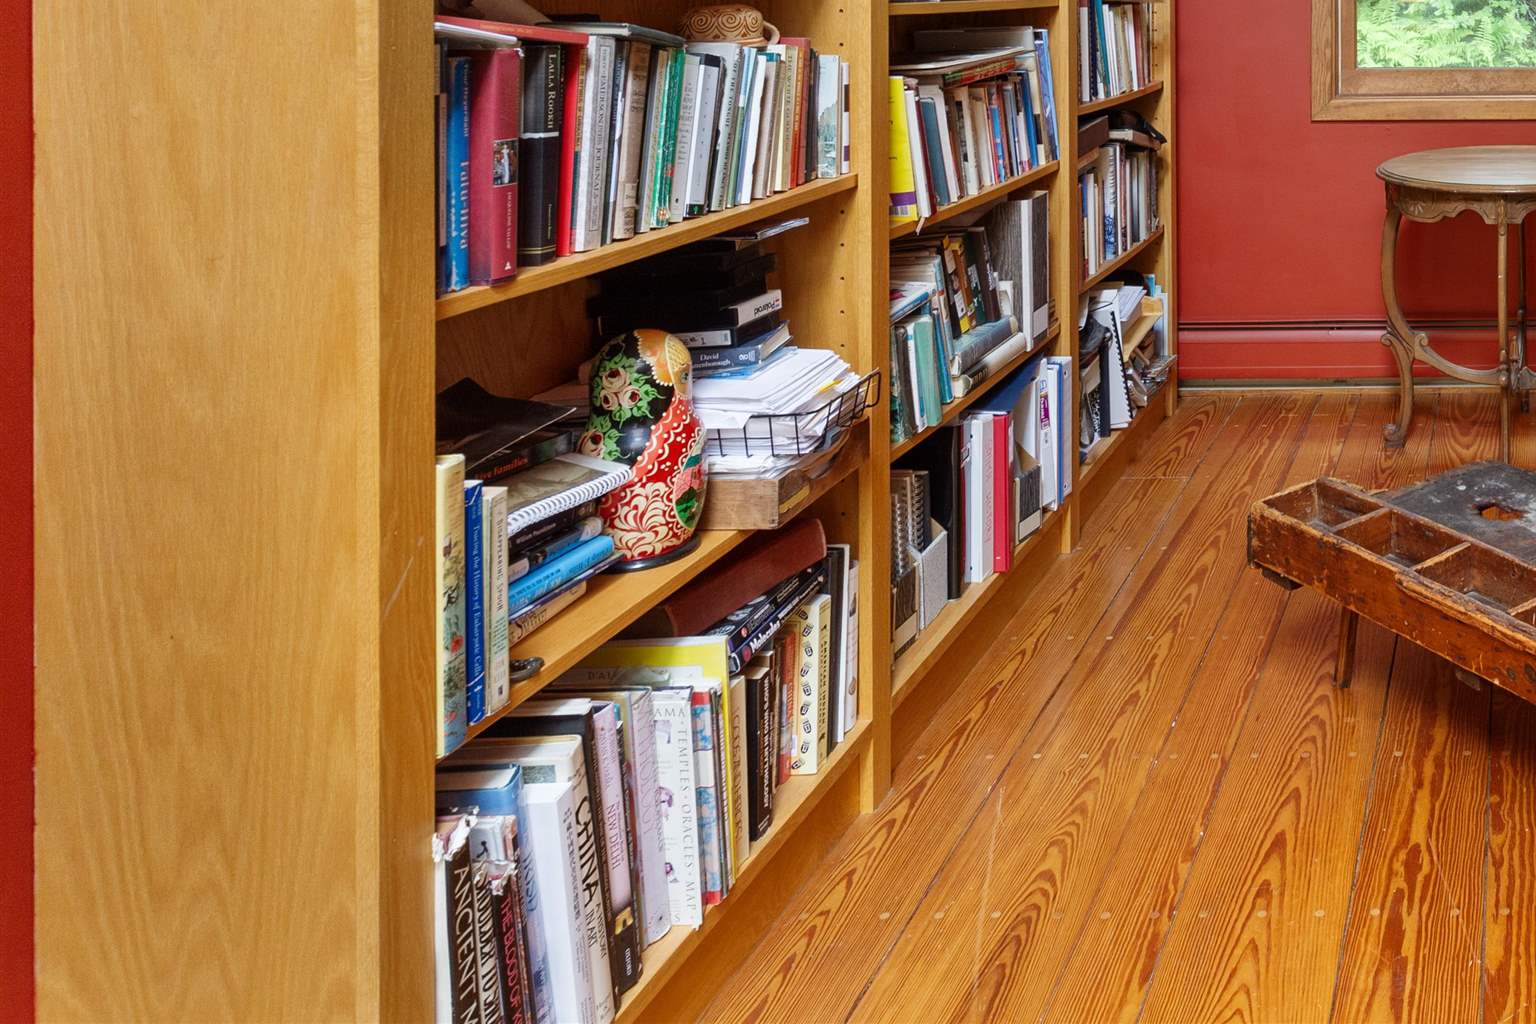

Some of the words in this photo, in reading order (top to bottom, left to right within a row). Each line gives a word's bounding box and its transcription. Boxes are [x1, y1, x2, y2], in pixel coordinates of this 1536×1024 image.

[548, 53, 556, 88] LALLA
[548, 91, 556, 129] ROOKH
[596, 74, 607, 124] EMERSON
[593, 147, 601, 198] JOURNALS
[754, 301, 775, 317] Polaroid
[496, 518, 504, 581] DISAPPEARING
[472, 570, 481, 601] History
[473, 612, 481, 655] Eukaryotic
[749, 620, 781, 654] Molecules
[474, 656, 482, 675] Cells
[678, 729, 689, 793] TEMPLES
[606, 804, 616, 832] NEW
[681, 803, 693, 869] ORACLES
[575, 795, 599, 908] CHINA
[608, 834, 620, 871] DELHI
[453, 864, 476, 1000] ANCIENT
[500, 896, 513, 932] THE
[598, 914, 607, 960] HISTORY
[503, 932, 519, 985] BLOOD
[481, 967, 497, 991] TO
[510, 986, 521, 1009] OF
